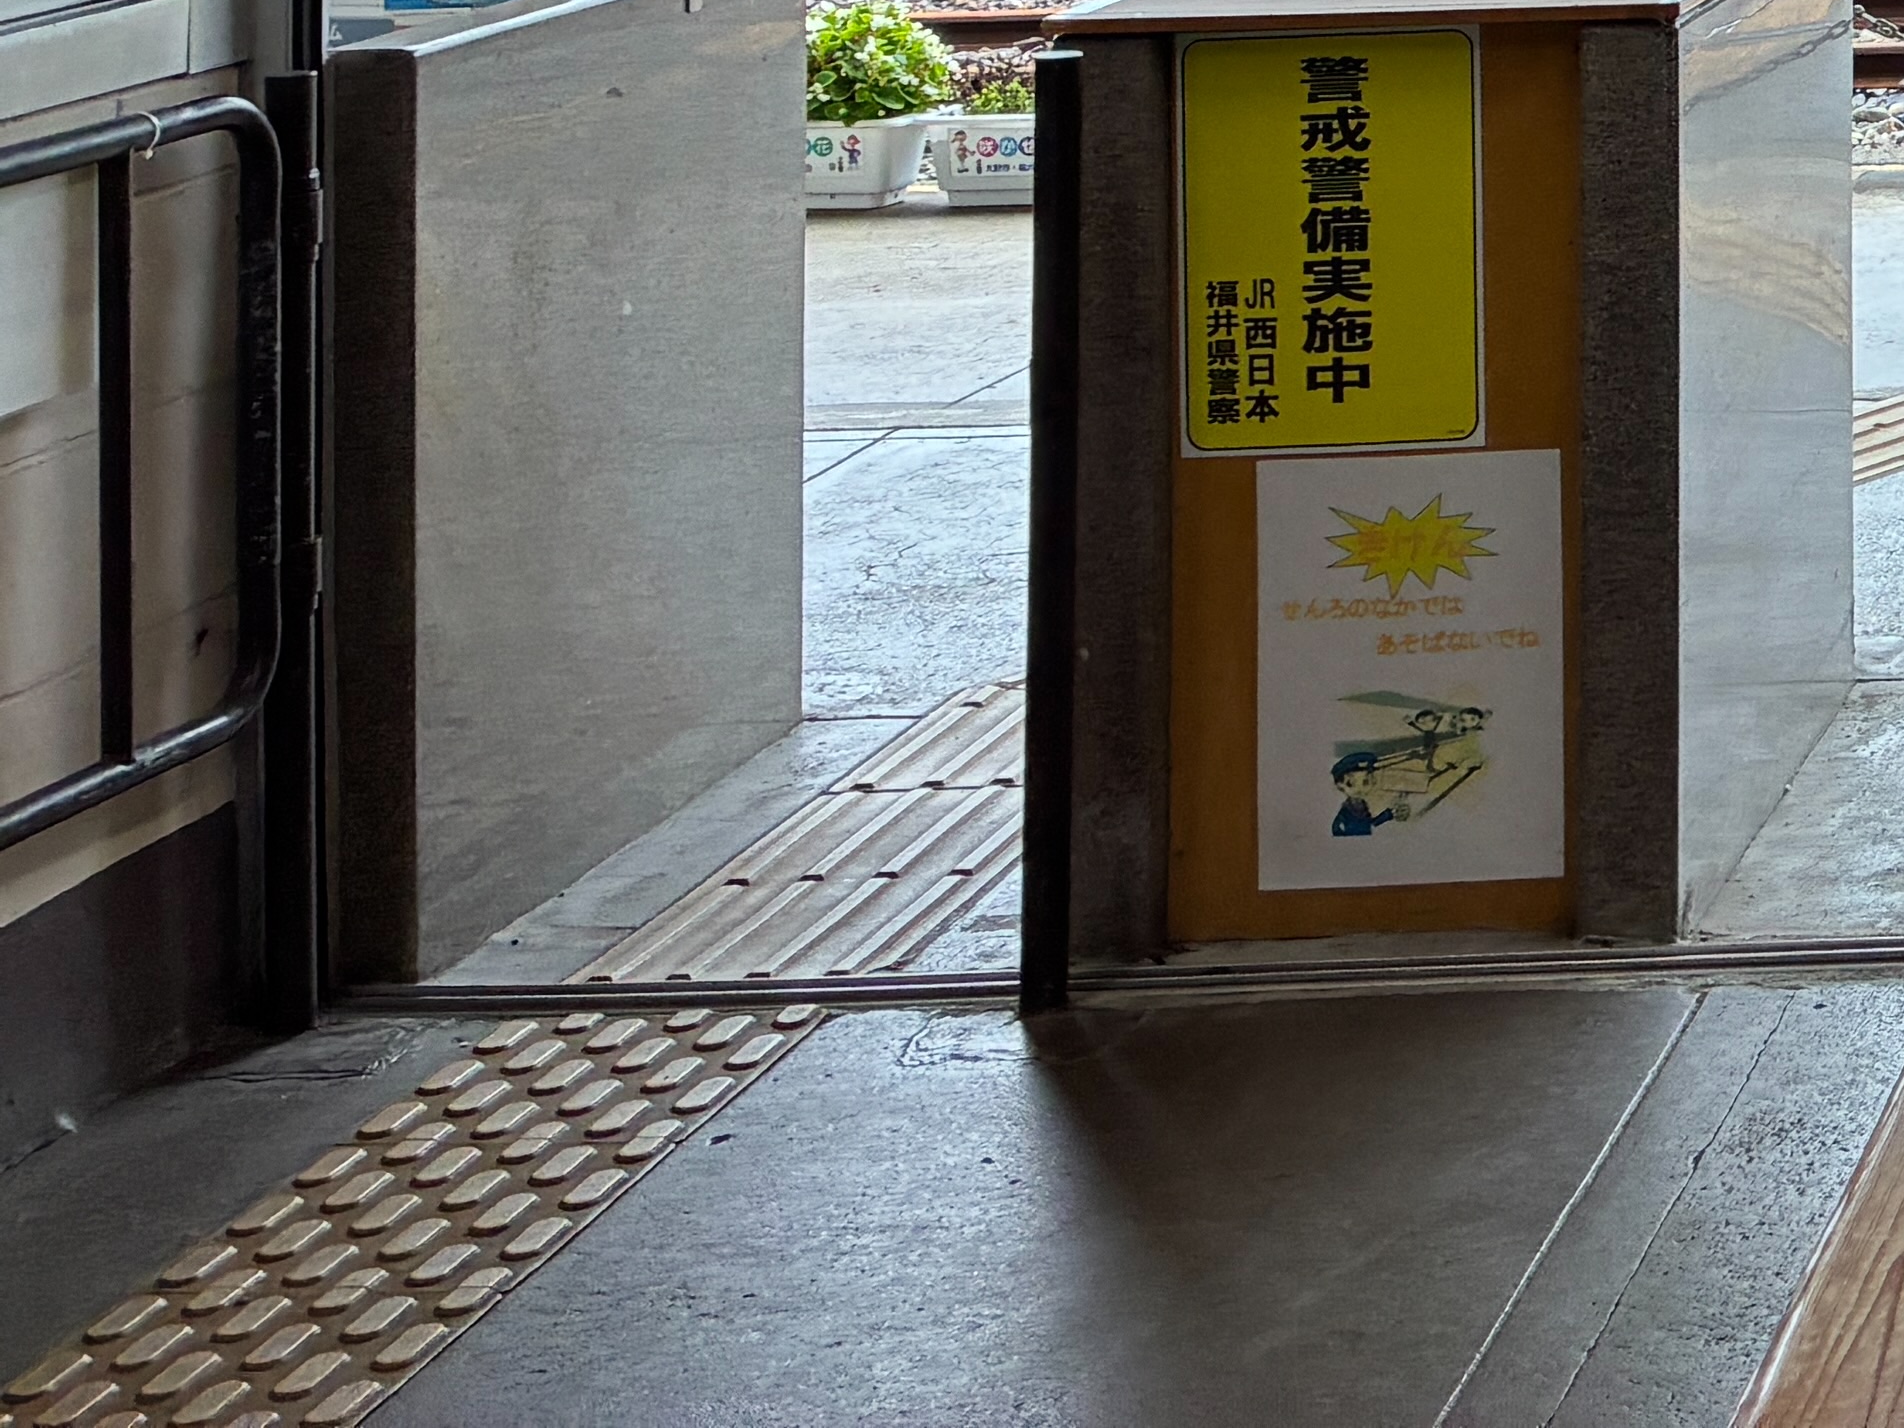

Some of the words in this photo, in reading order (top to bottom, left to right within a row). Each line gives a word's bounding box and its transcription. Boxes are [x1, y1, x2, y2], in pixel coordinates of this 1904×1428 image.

[1301, 56, 1372, 404] 警戒警備実施中
[1207, 281, 1241, 425] 福井県警察
[1244, 278, 1279, 424] JR西日本
